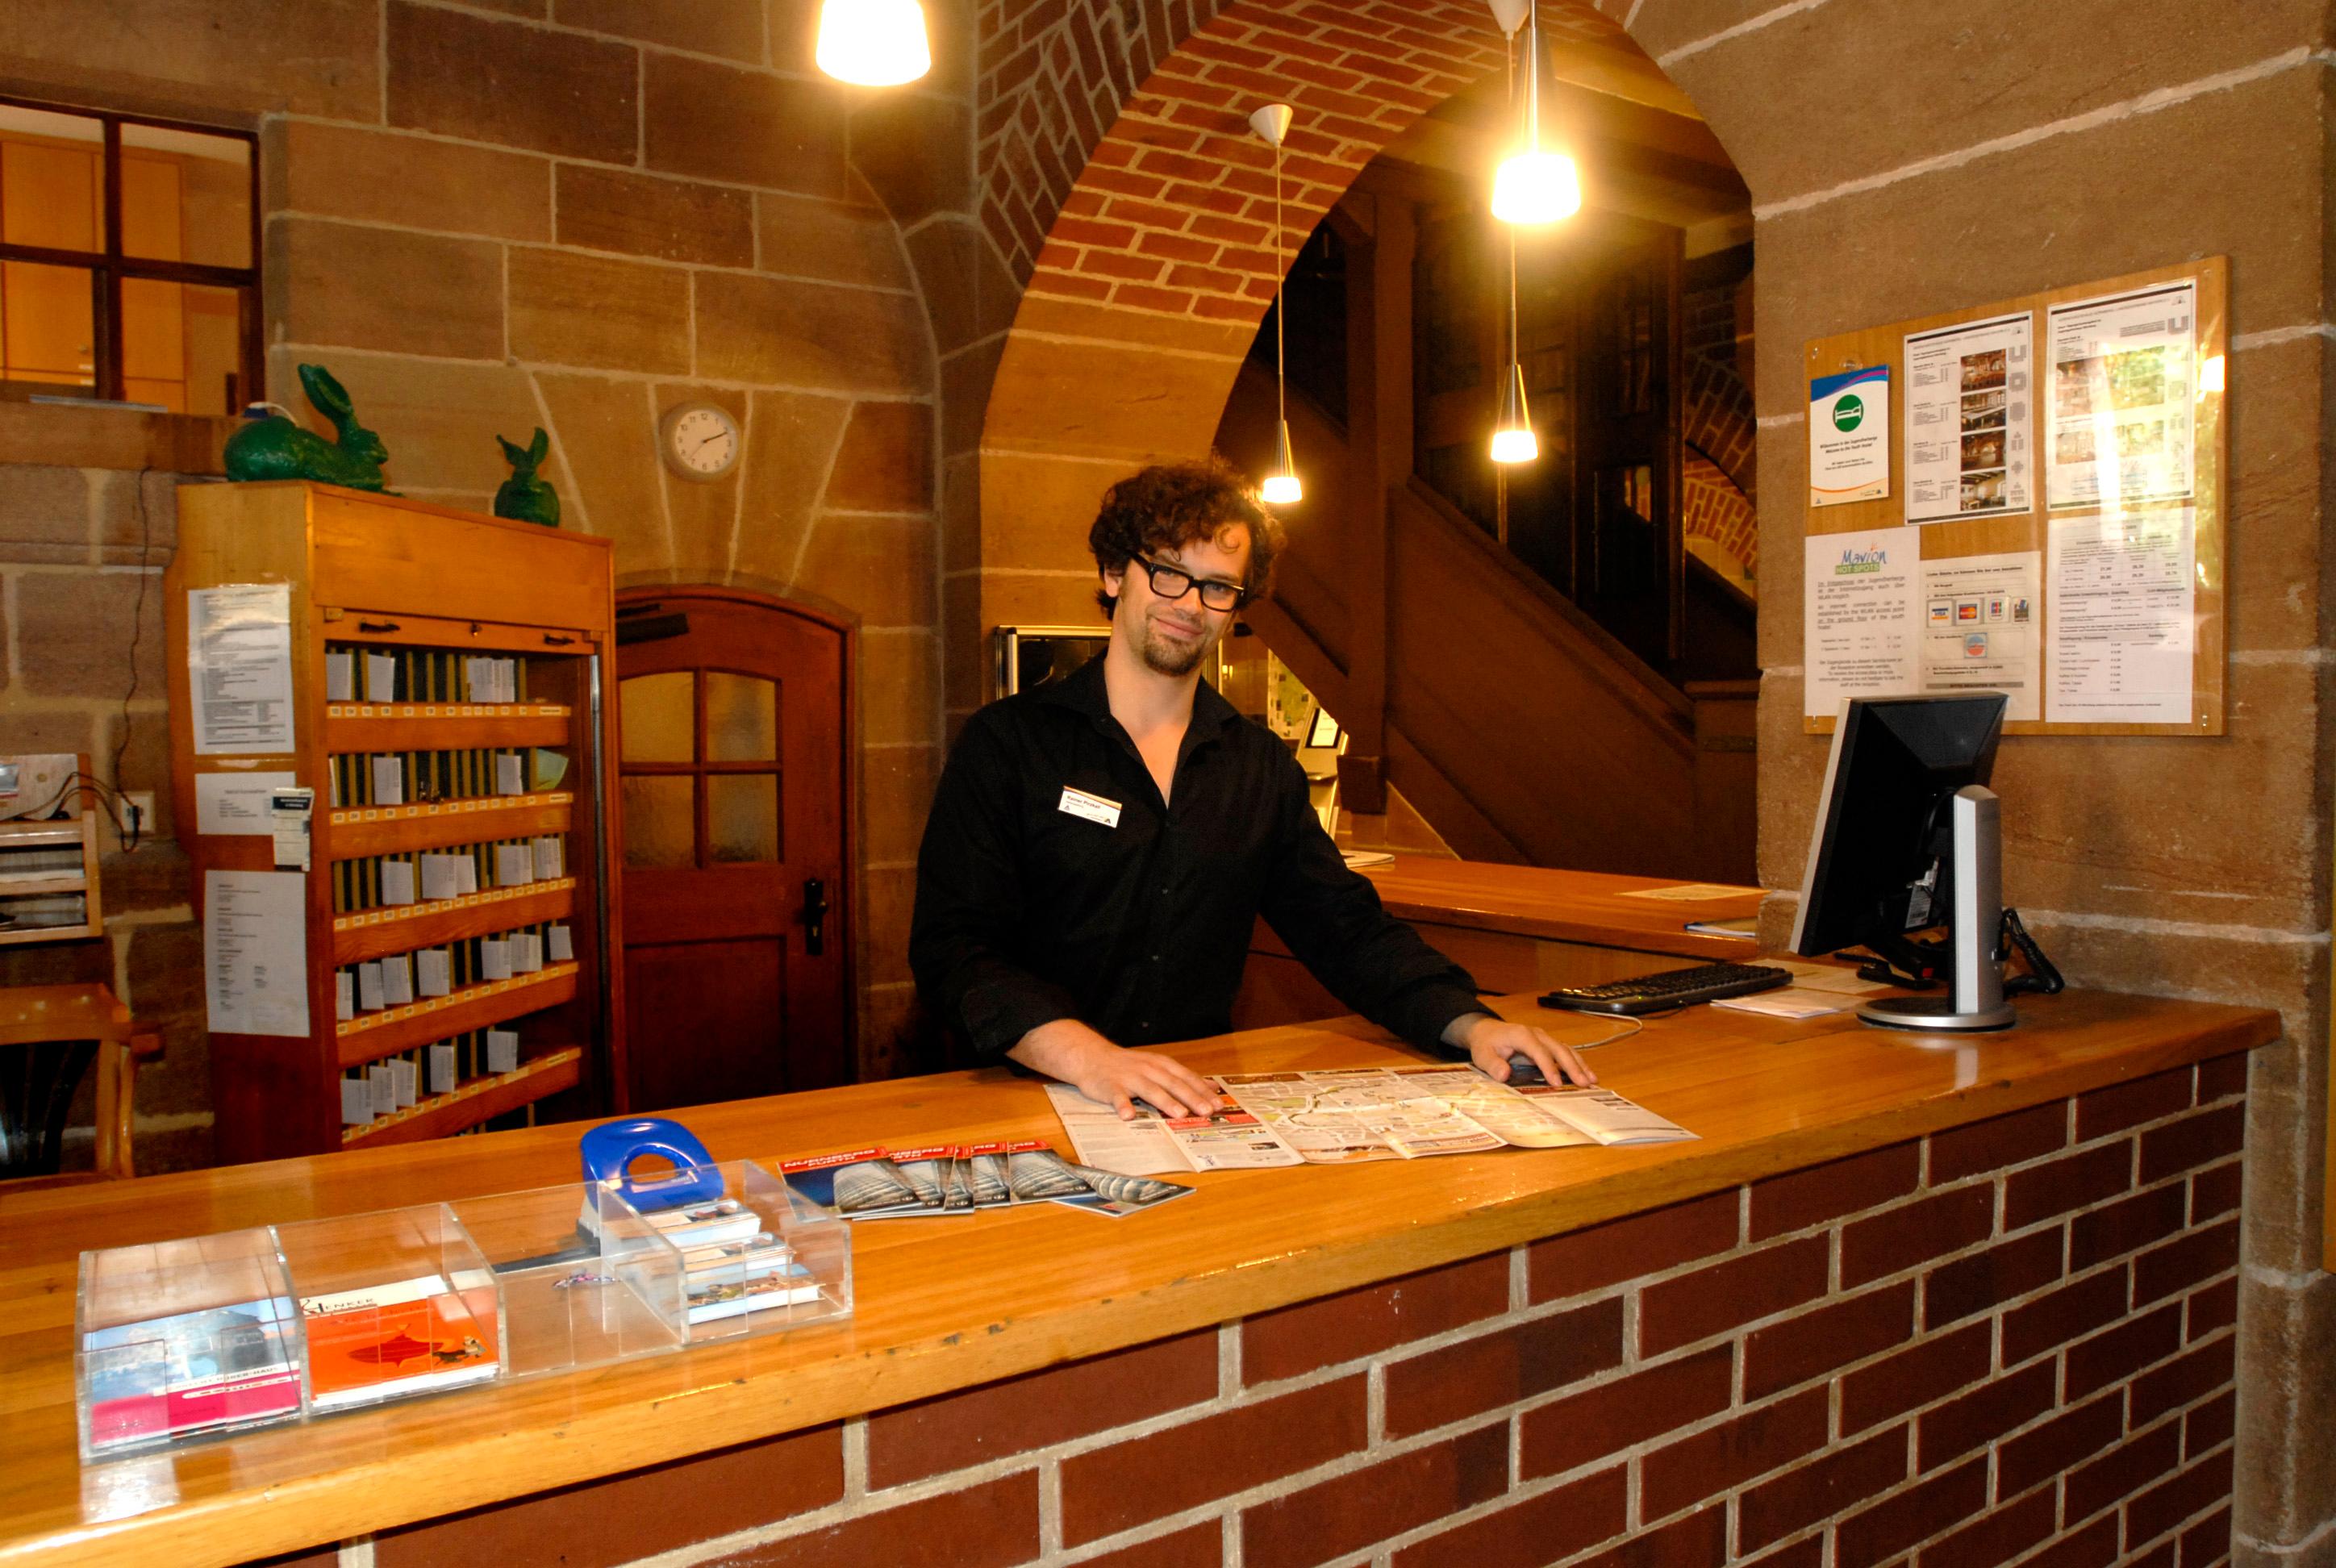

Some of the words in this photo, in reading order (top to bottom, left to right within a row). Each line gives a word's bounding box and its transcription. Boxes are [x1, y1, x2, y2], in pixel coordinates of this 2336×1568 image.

[1842, 549, 1887, 567] Mavion
[1837, 565, 1851, 574] HOT
[1854, 562, 1880, 573] SPOTS
